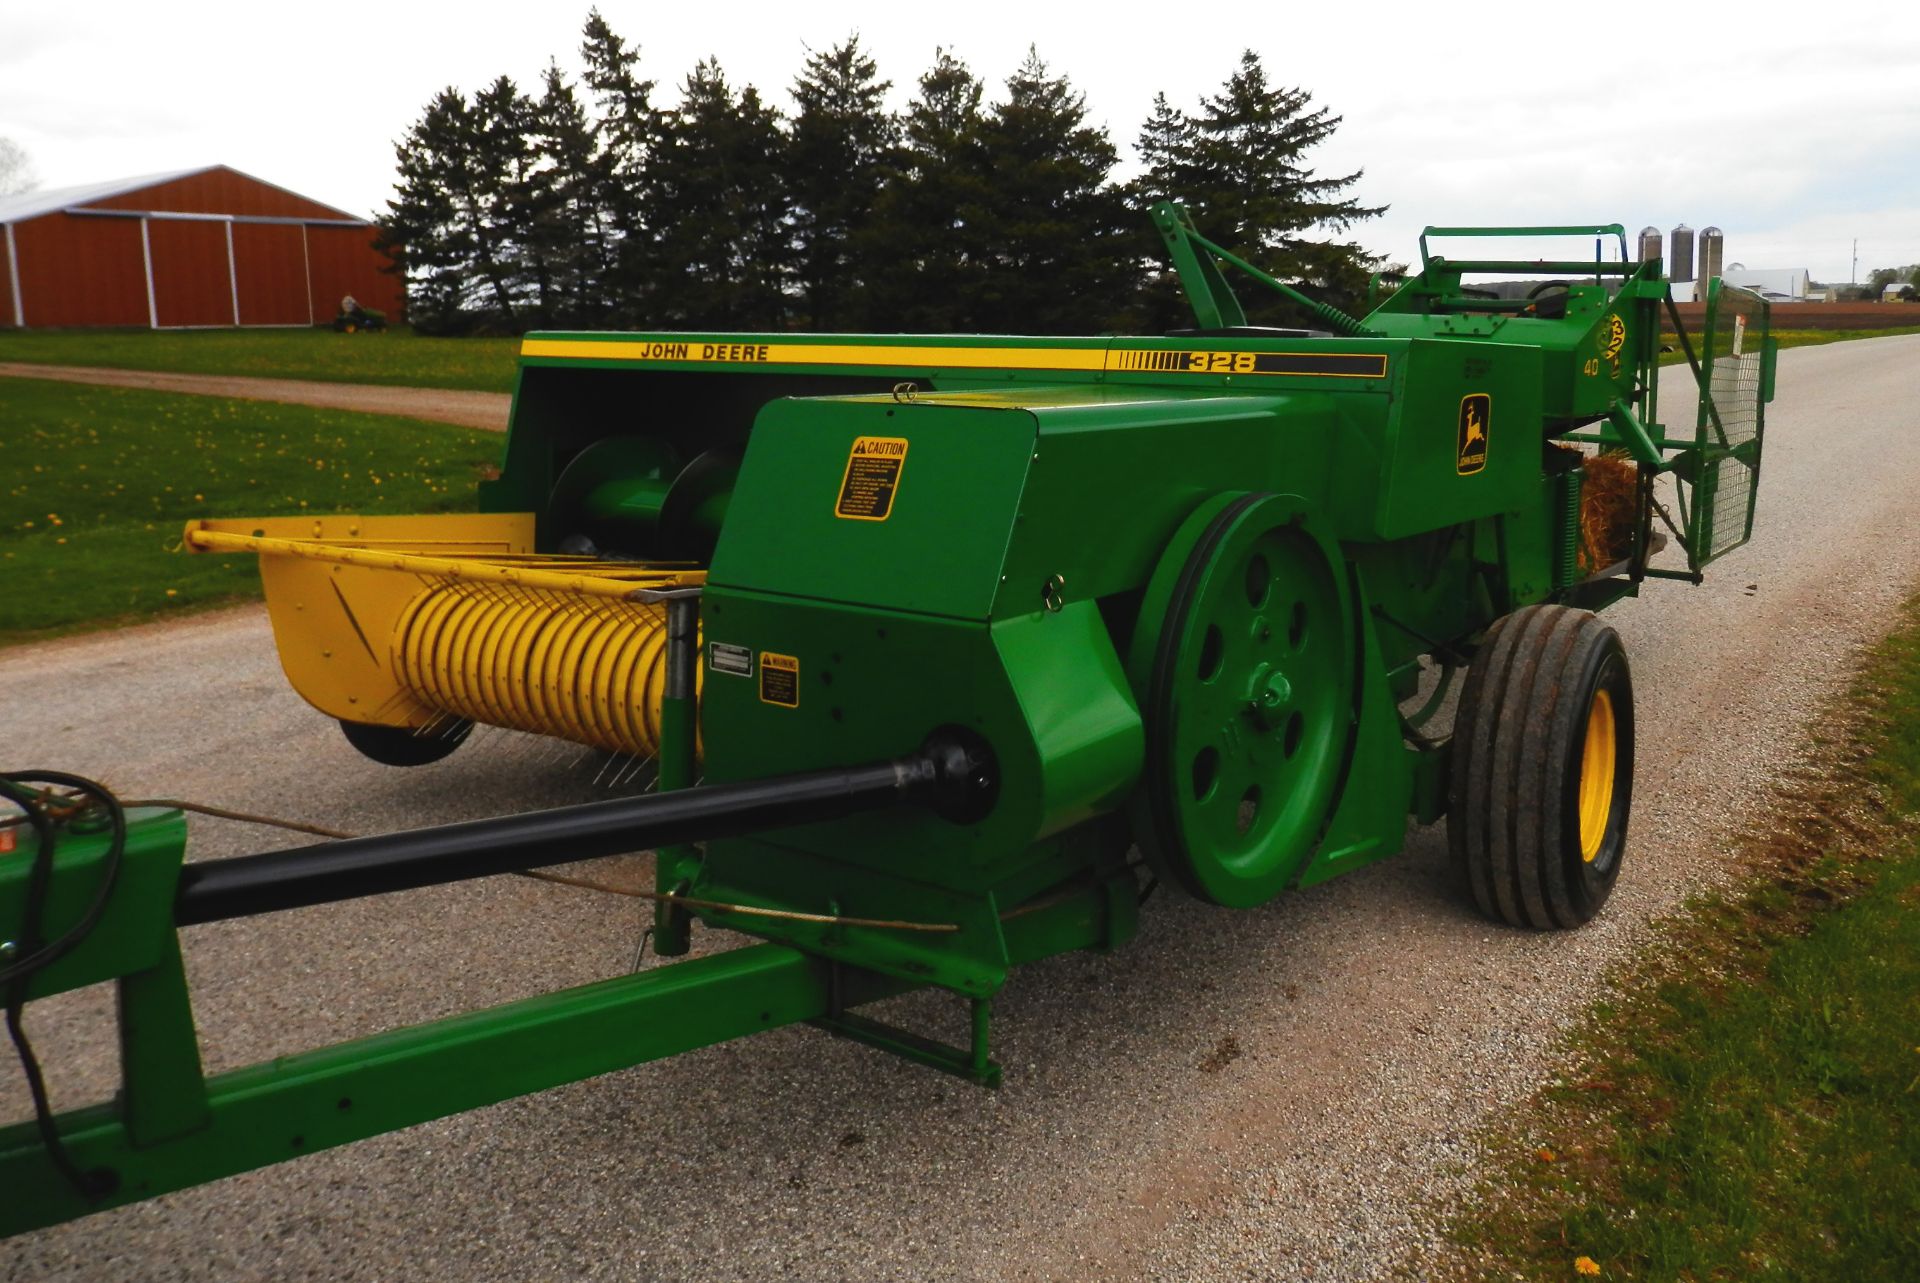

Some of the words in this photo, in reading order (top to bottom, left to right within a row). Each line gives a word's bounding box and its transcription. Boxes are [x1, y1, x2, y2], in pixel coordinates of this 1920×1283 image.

[640, 343, 689, 359] JOHN
[702, 344, 769, 361] DEERE
[1188, 351, 1257, 373] 328
[1583, 358, 1599, 376] 40
[867, 441, 905, 455] CAUTION
[1459, 456, 1470, 467] JOHN
[1471, 453, 1484, 464] DEERE
